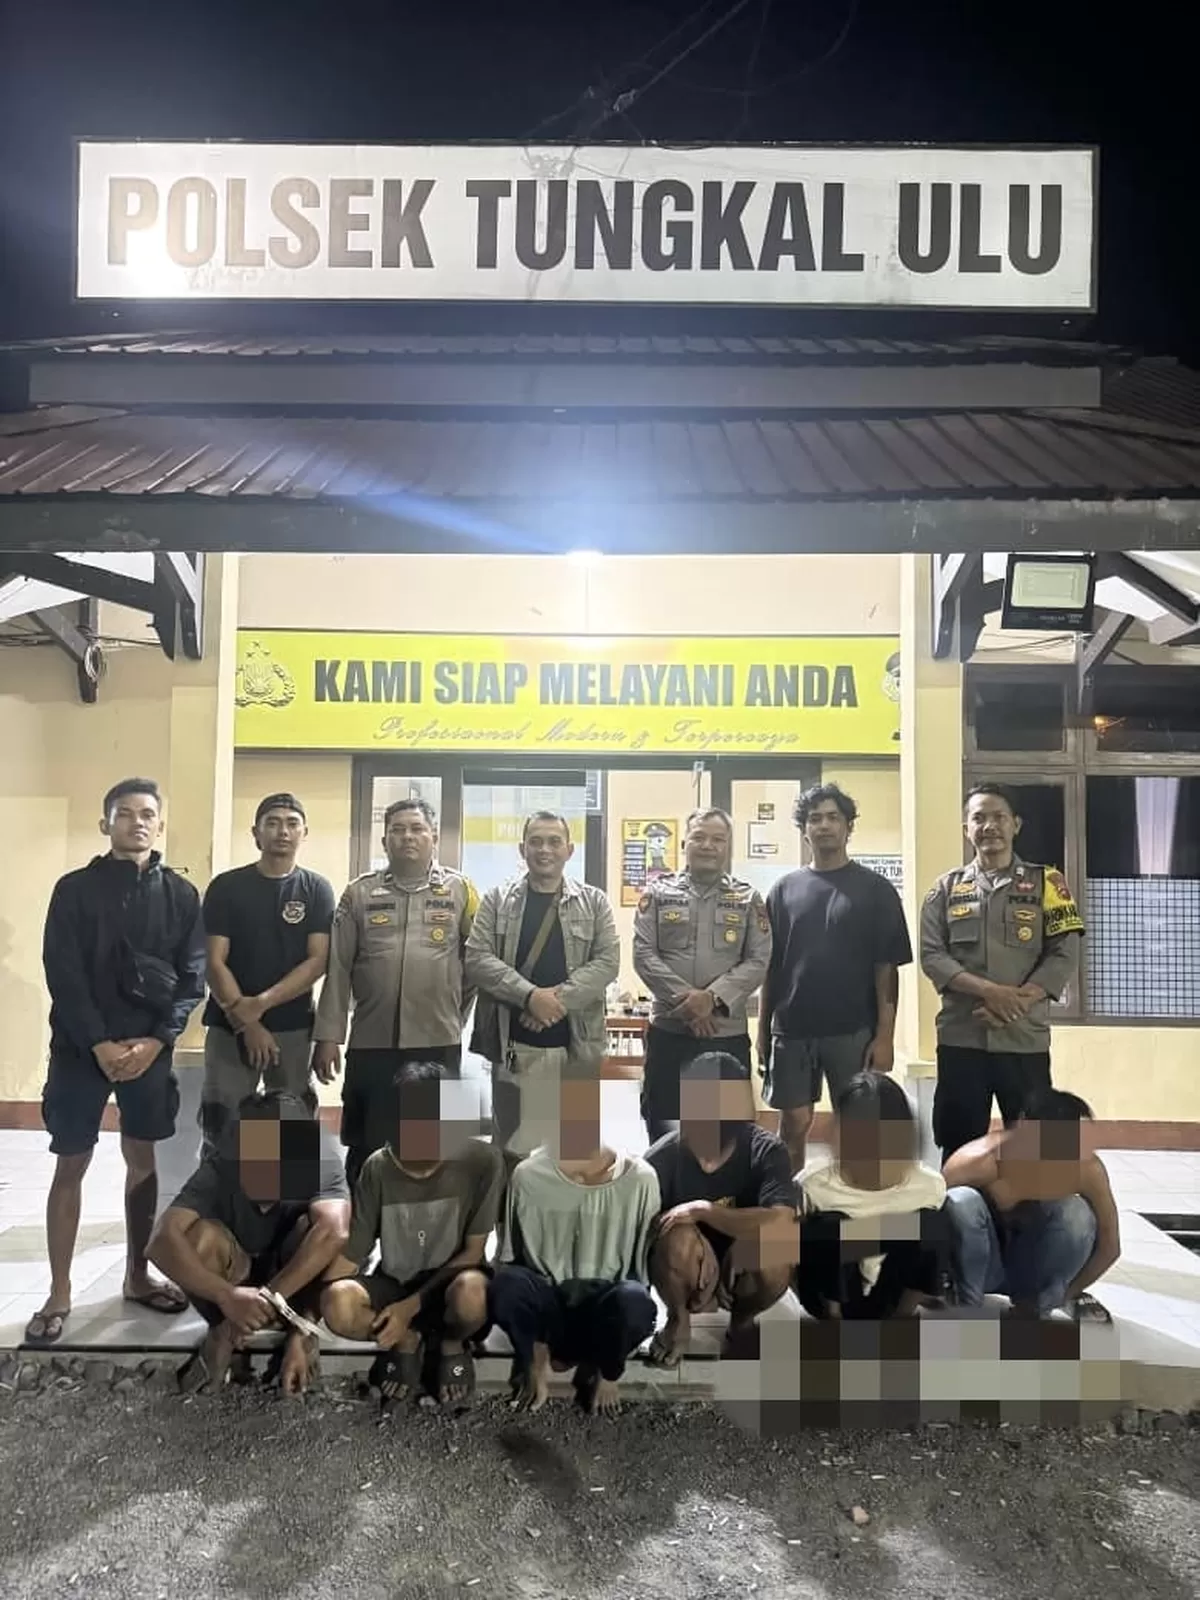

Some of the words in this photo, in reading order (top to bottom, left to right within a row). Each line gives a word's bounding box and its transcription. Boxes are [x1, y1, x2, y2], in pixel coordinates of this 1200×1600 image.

[107, 176, 438, 270] POLSEK
[465, 178, 865, 272] TUNGKAL
[898, 181, 1063, 275] ULU
[314, 659, 422, 703] KAMI
[433, 660, 528, 705] SIAP
[539, 662, 734, 706] MELAYANI
[744, 664, 859, 708] ANDA
